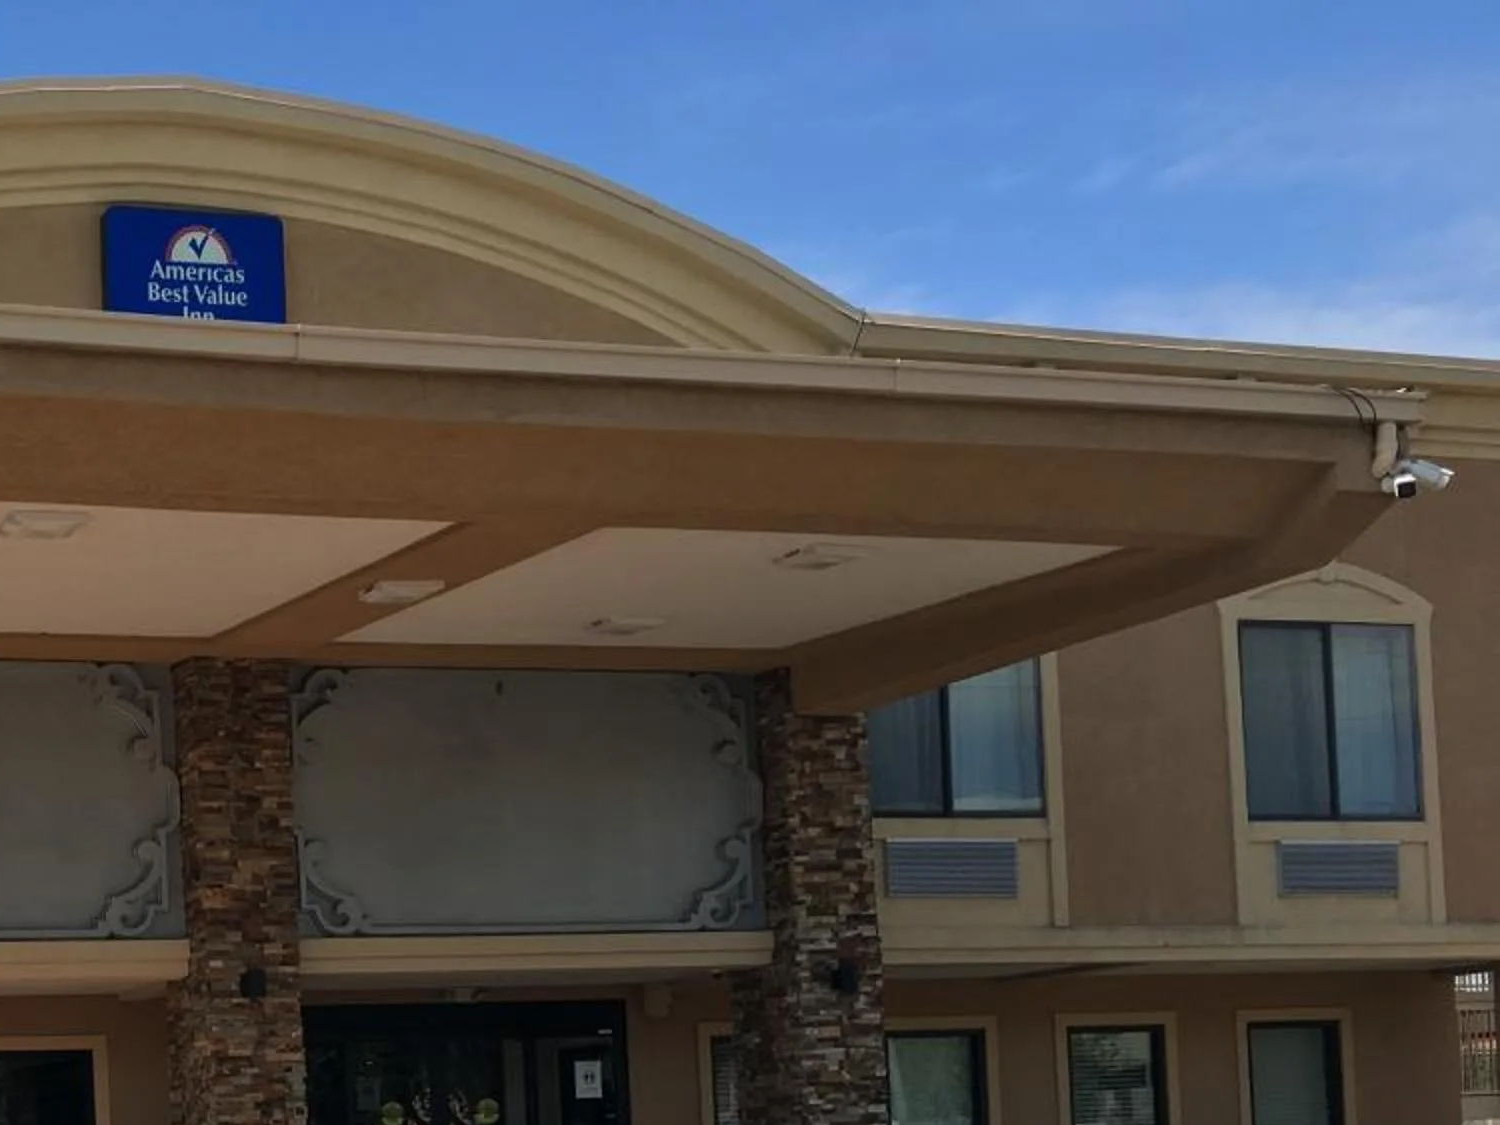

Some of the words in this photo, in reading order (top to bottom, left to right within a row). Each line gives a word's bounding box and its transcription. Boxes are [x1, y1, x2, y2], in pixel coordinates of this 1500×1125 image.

[150, 259, 245, 283] Americas
[148, 281, 190, 304] Best
[192, 284, 248, 306] Value
